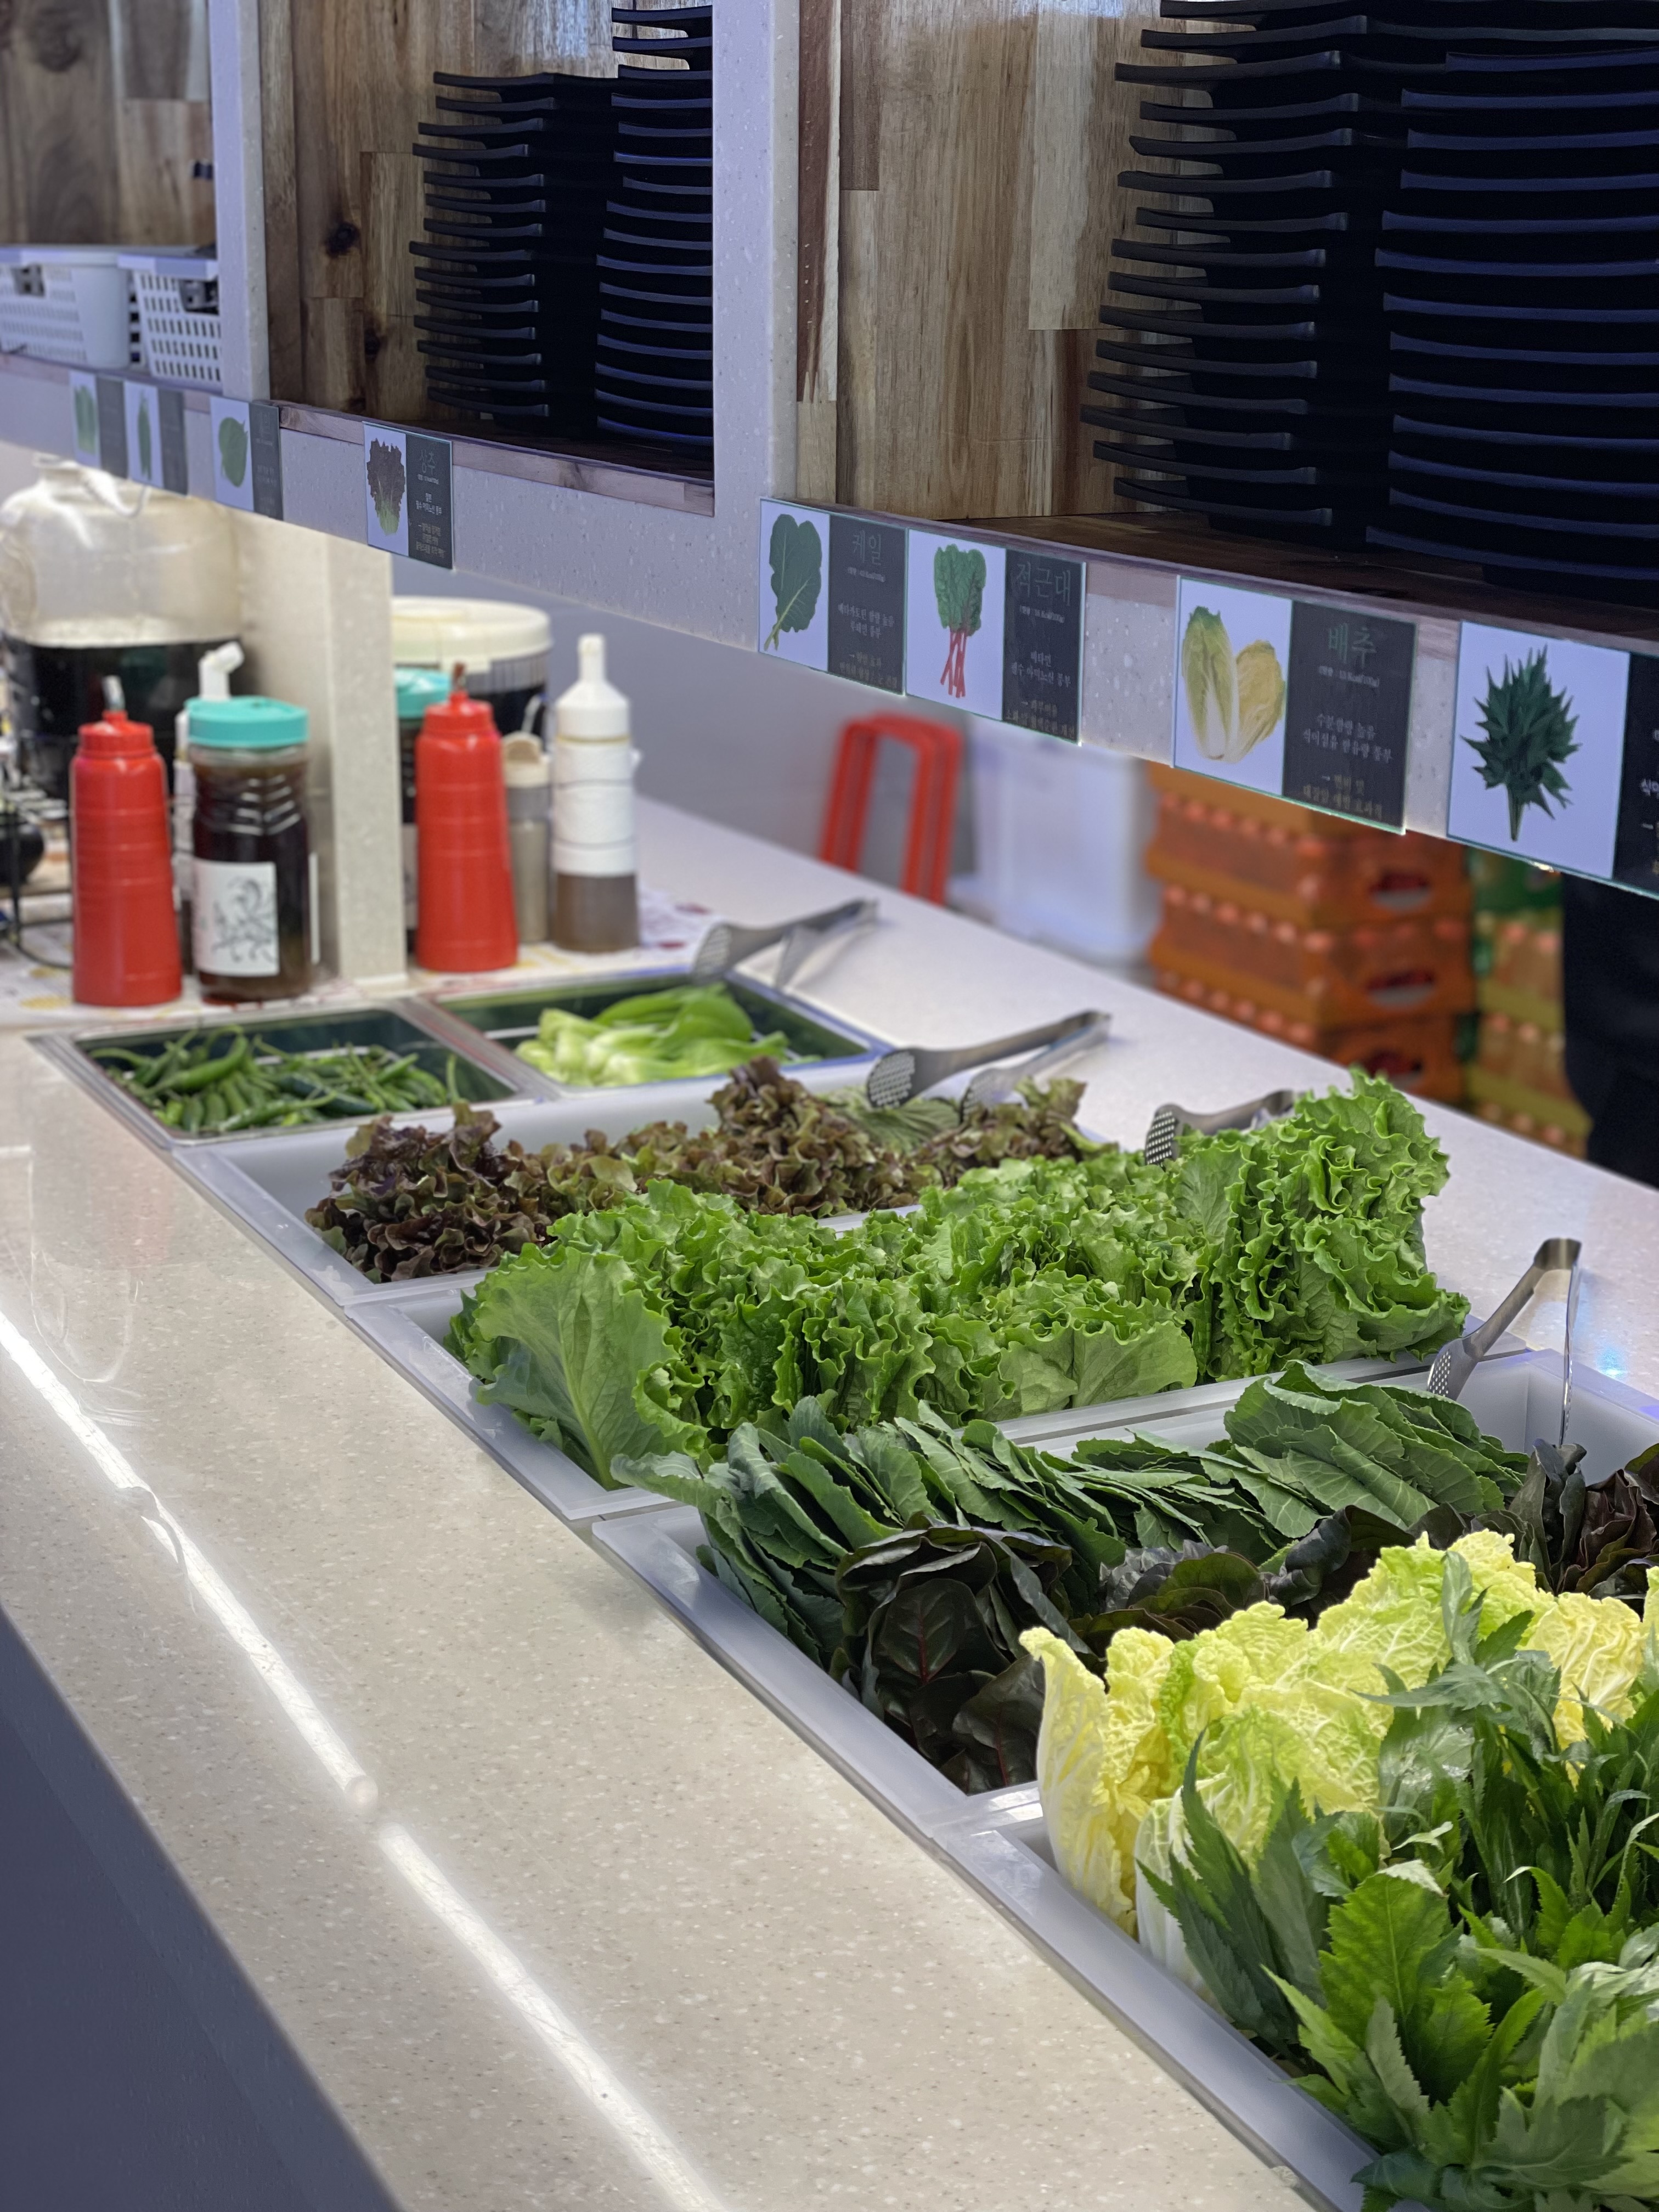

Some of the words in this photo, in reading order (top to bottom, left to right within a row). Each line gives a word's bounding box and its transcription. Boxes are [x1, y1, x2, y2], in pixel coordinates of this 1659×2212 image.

[852, 530, 882, 566] 케일
[1017, 561, 1071, 607] 적근대
[1030, 650, 1052, 668] 비타민
[1328, 623, 1378, 669] 배추
[1026, 663, 1054, 685] 아미노산
[1057, 672, 1071, 687] 풍부
